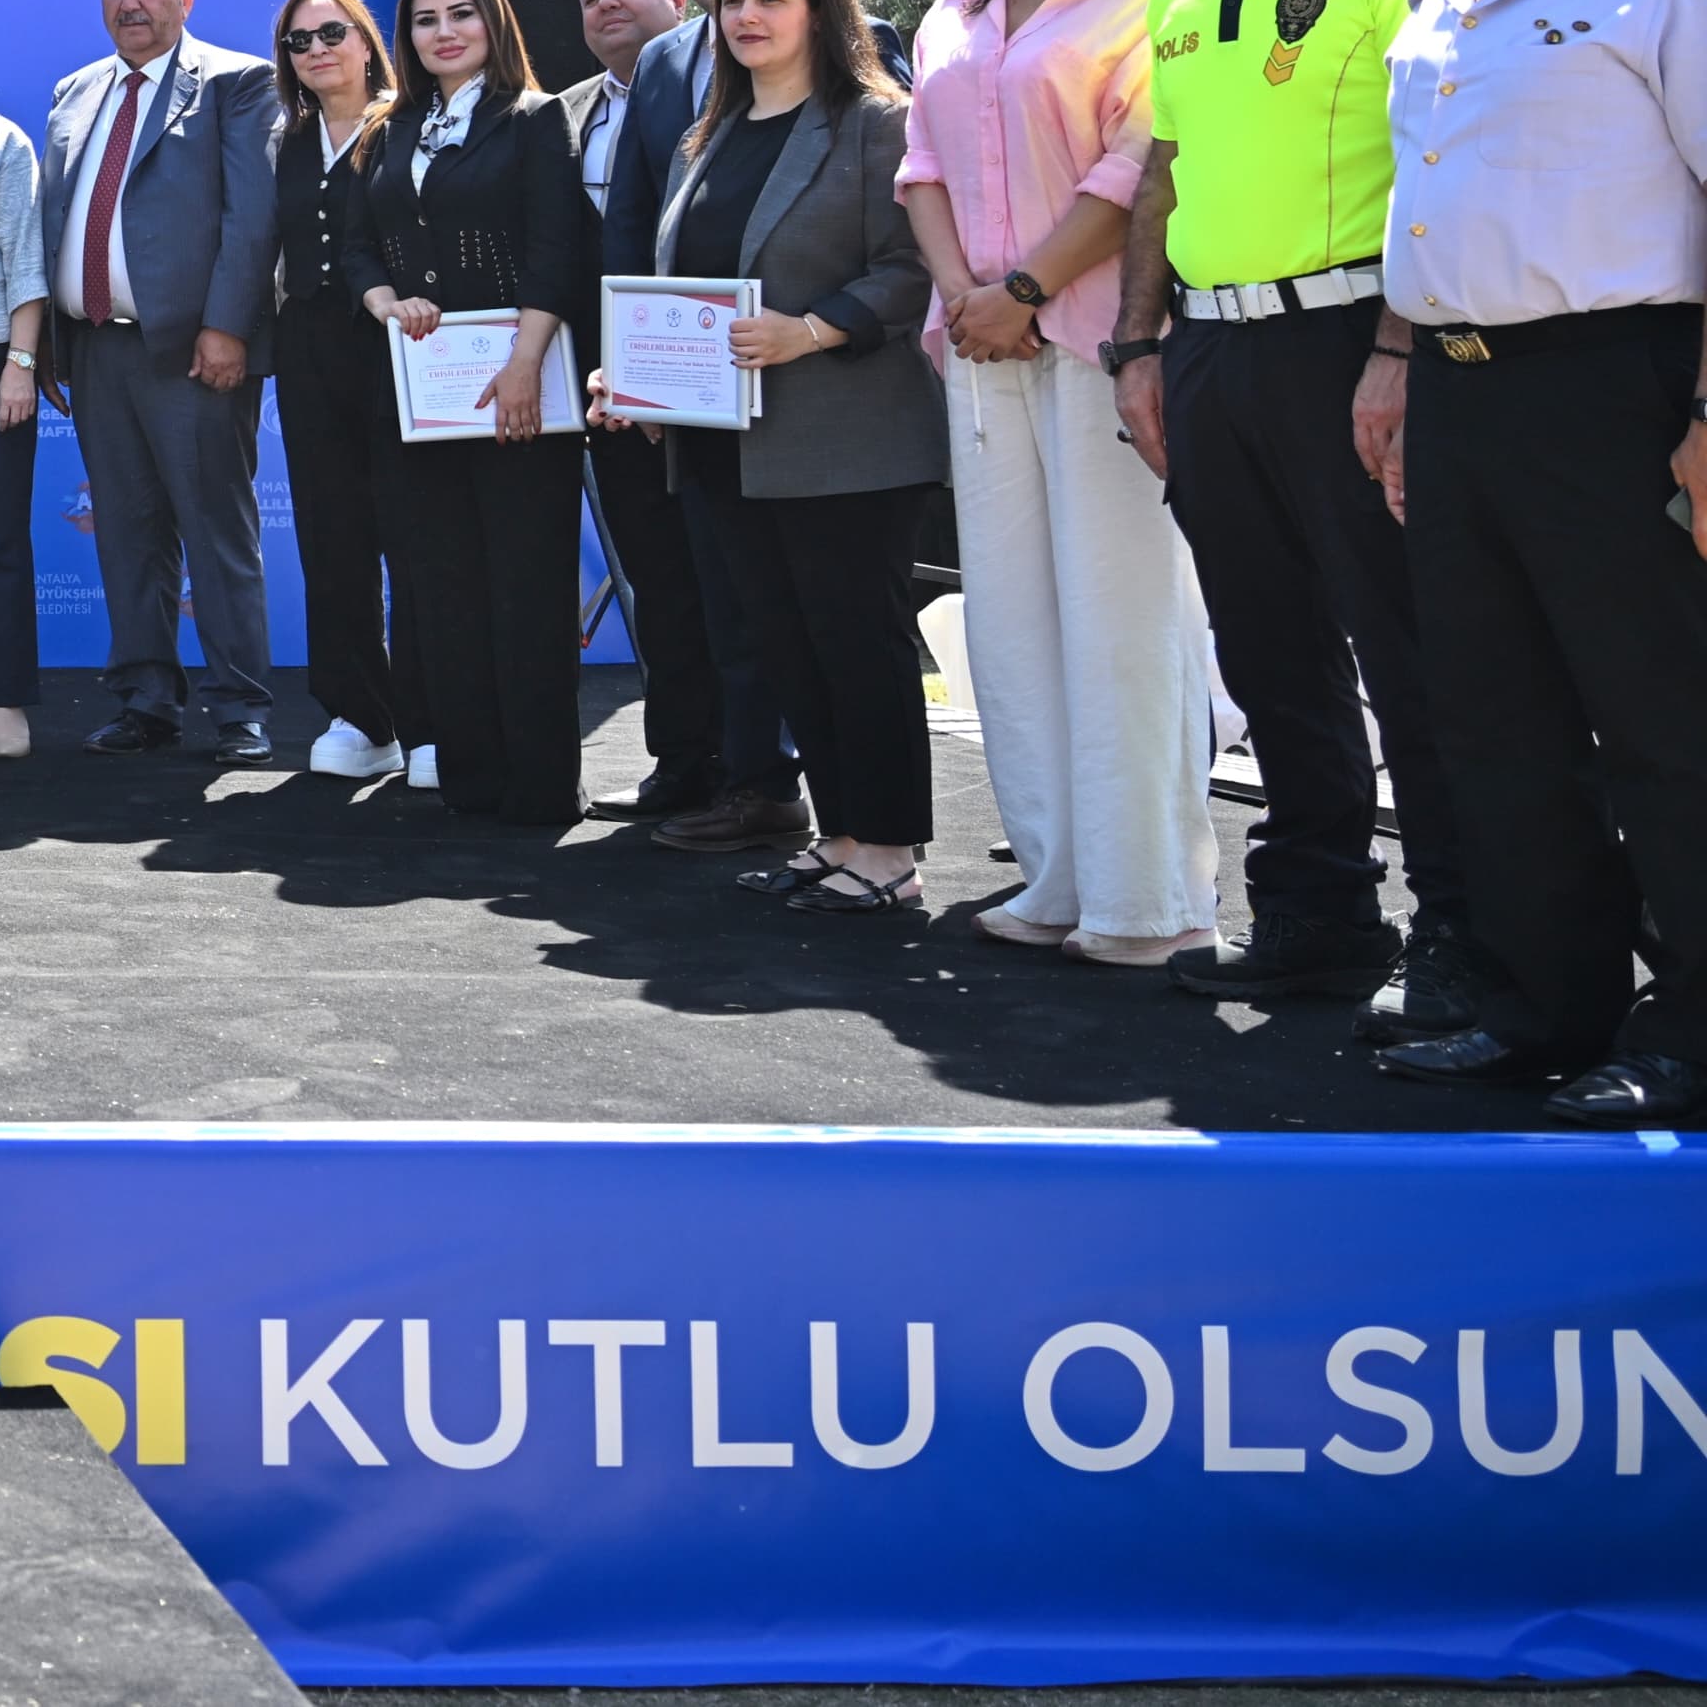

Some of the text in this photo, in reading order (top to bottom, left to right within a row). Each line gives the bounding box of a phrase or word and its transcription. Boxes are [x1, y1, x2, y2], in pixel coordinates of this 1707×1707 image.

[36, 573, 82, 585] NTALYA
[35, 600, 92, 615] ELEDİYESİ
[259, 1318, 936, 1471] KUTLU
[1022, 1322, 1707, 1478] OLSUN
